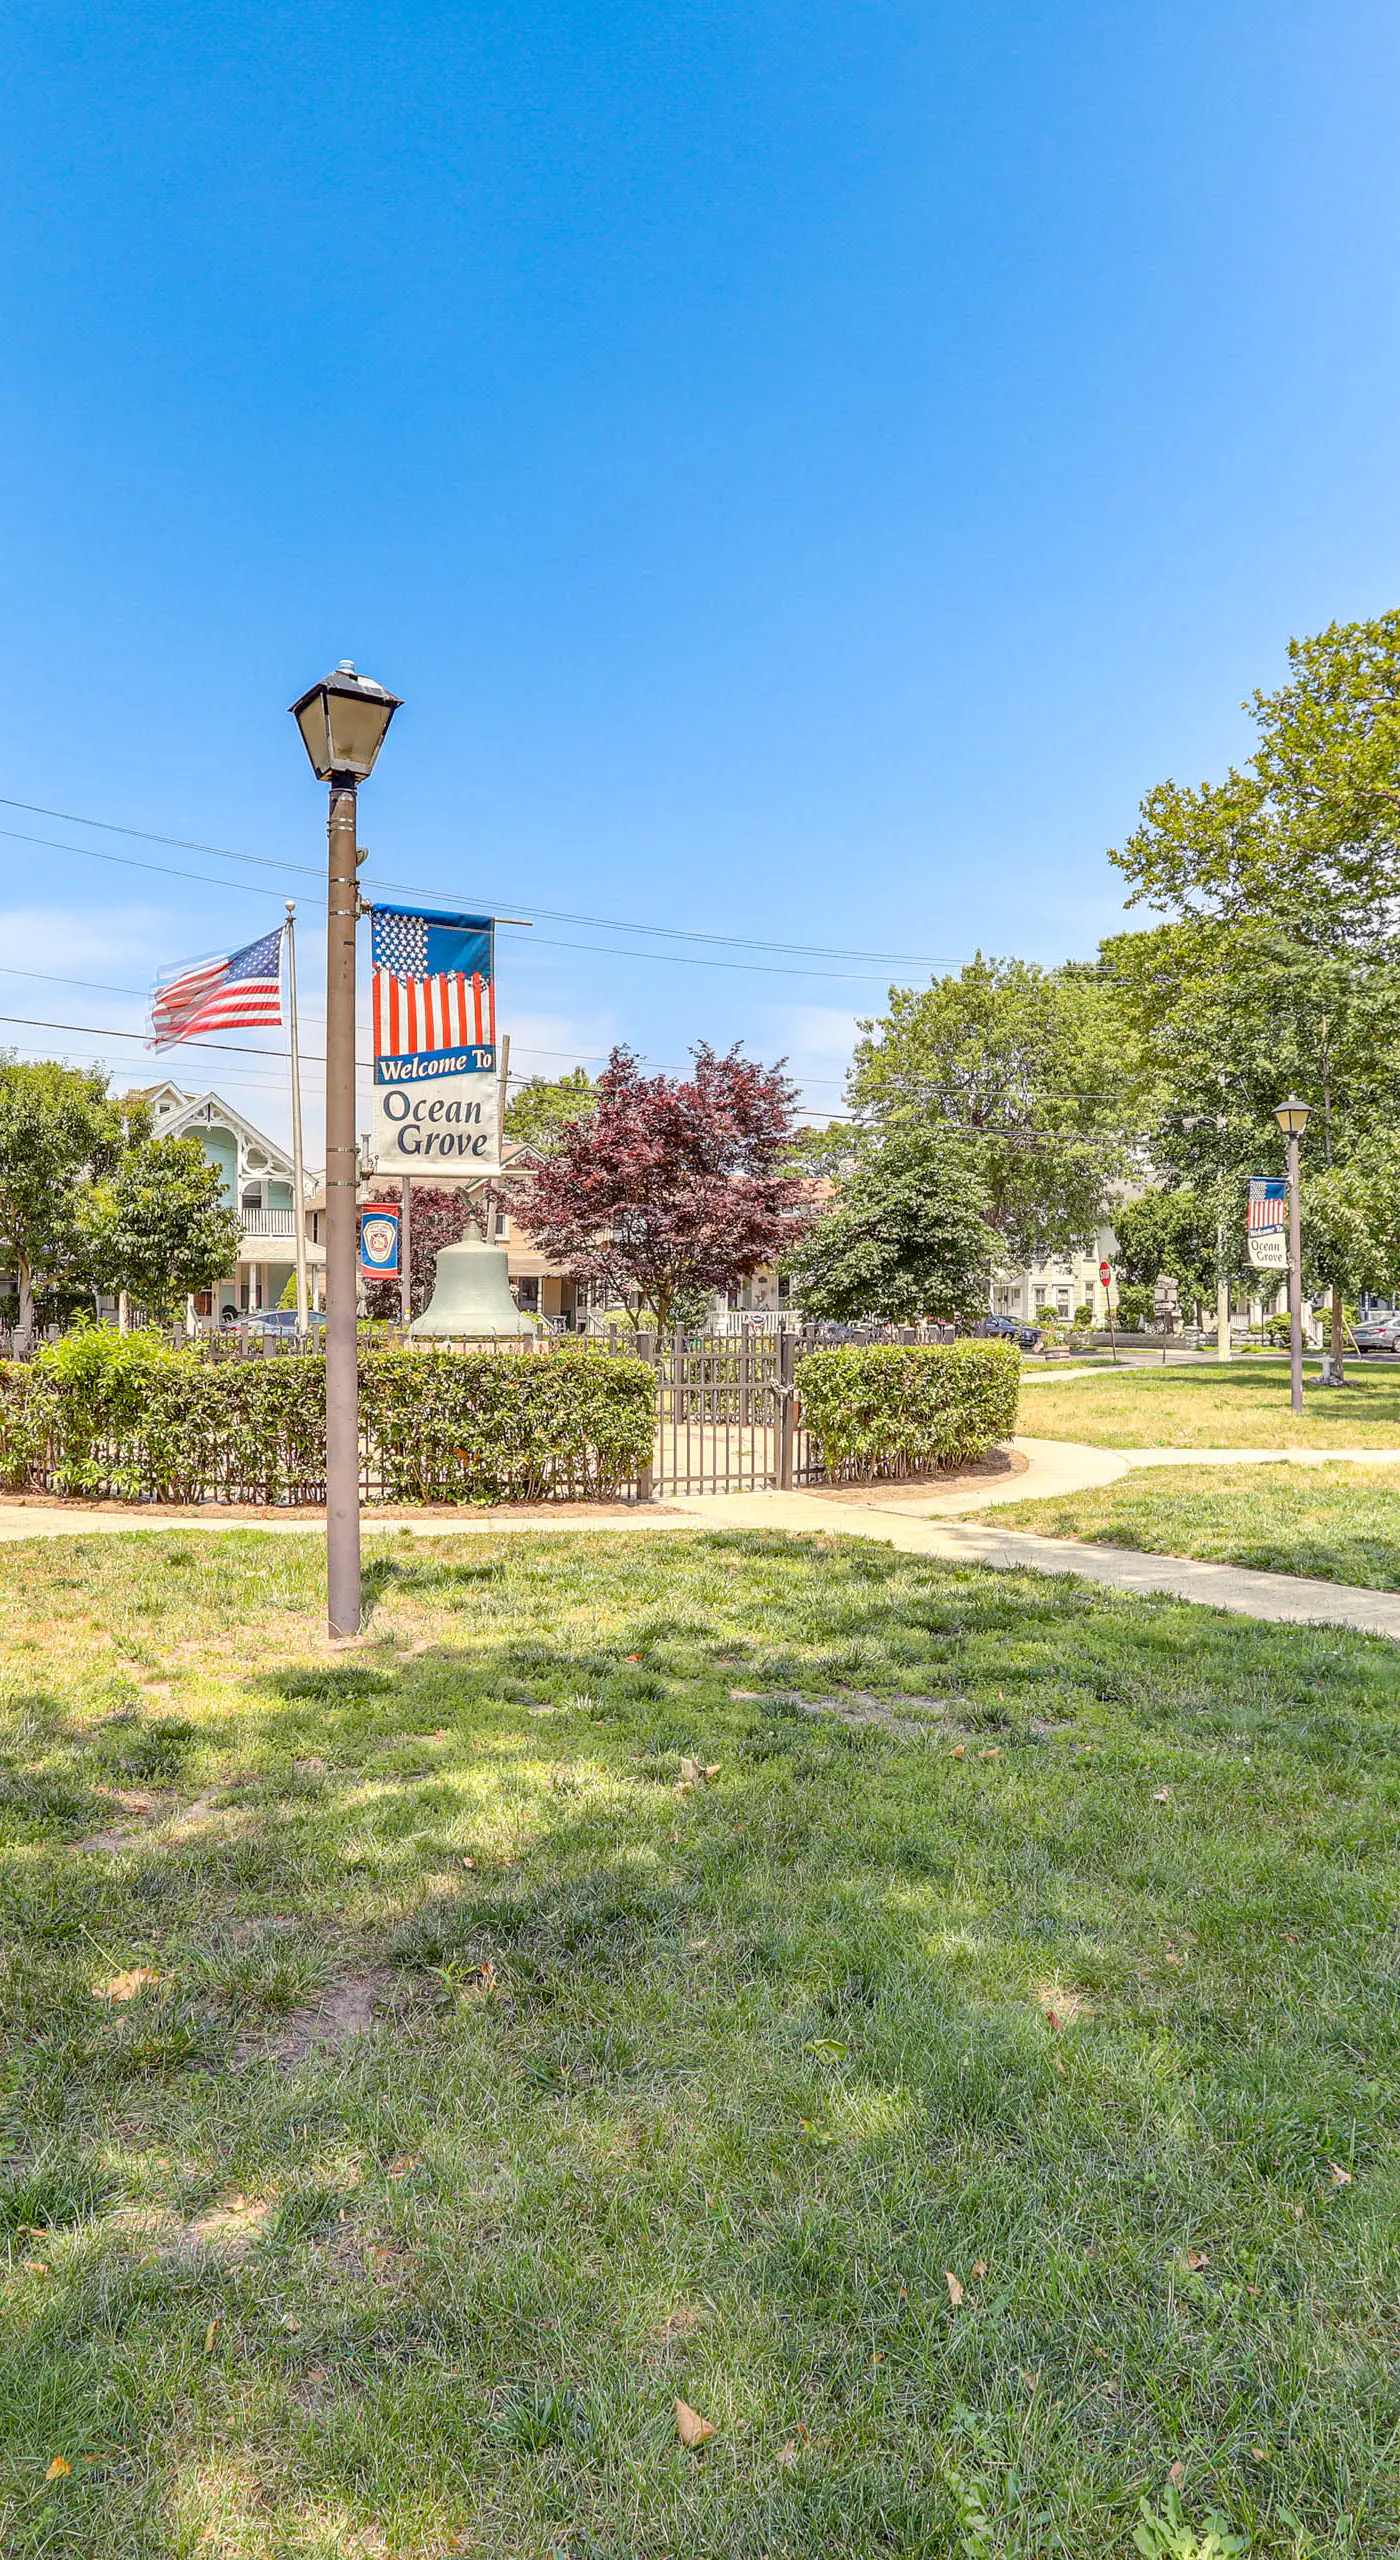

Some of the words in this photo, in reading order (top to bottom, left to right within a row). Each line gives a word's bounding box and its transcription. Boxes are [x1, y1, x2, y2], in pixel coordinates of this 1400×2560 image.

[380, 1056, 467, 1080] Welcome
[472, 1050, 492, 1068] To
[383, 1090, 482, 1124] Ocean
[397, 1124, 488, 1156] Grove
[1251, 1240, 1280, 1251] Ocean
[1256, 1251, 1283, 1262] Grove
